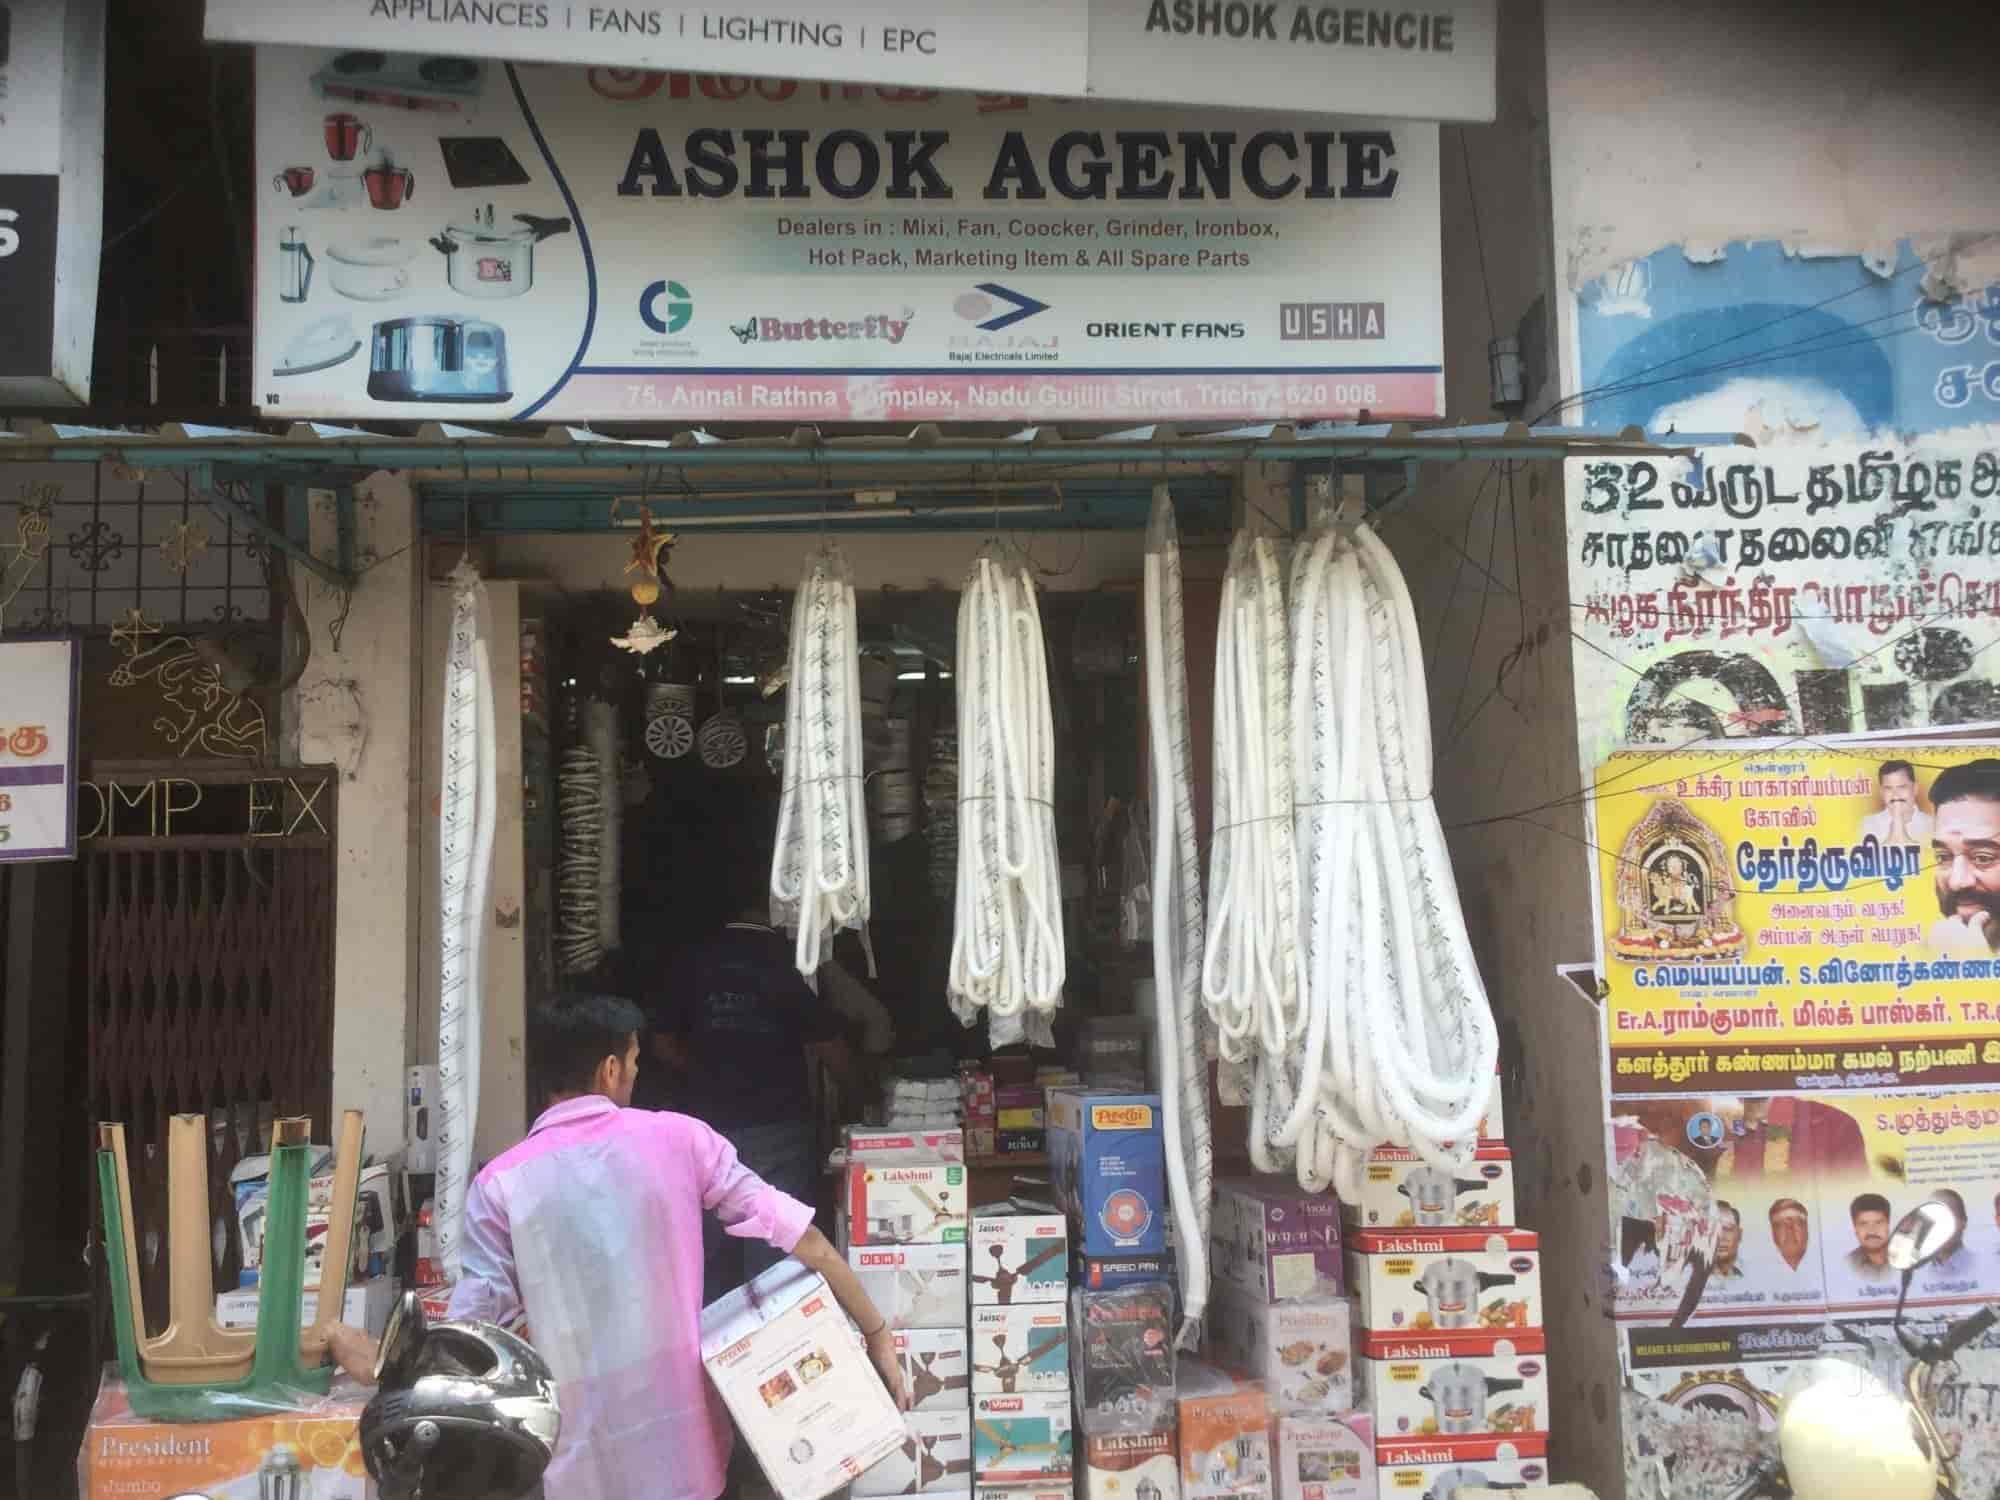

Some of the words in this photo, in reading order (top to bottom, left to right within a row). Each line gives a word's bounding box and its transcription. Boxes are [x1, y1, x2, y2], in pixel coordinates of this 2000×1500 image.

[370, 0, 548, 28] APPLIANCES
[589, 8, 662, 36] FANS
[703, 15, 843, 48] LIGHTING
[882, 27, 937, 54] EPC
[1145, 0, 1278, 41] ASHOK
[1289, 7, 1455, 52] AGENCIE
[617, 128, 953, 200] ASHOK
[982, 129, 1400, 201] AGENCIE
[777, 218, 857, 236] Dealers
[864, 218, 882, 236] in
[903, 218, 950, 238] Mixi,
[957, 218, 1002, 238] Fan,
[1008, 218, 1099, 239] Coocker,
[1106, 218, 1189, 239] Grinder,
[1195, 219, 1280, 240] Ironbox,
[809, 248, 845, 265] Hot
[852, 248, 909, 268] Pack,
[915, 248, 1018, 270] Marketing
[1024, 249, 1069, 266] Item
[1074, 249, 1091, 266] &
[1096, 249, 1124, 266] All
[1131, 249, 1190, 270] Spare
[1197, 249, 1250, 266] Parts
[1086, 322, 1176, 338] ORIENT
[1181, 322, 1245, 338] FANS
[1282, 305, 1384, 338] USHA
[671, 383, 743, 408] Annai
[751, 383, 838, 408] Rathna
[967, 383, 1032, 407] Nadu
[1737, 833, 1921, 893] தேர்திருவிழா
[1371, 1147, 1418, 1161] akshmi
[883, 1169, 933, 1182] Lakshmi
[1376, 1238, 1444, 1253] Lakshmi
[1383, 1344, 1450, 1360] Lakshmi
[101, 1435, 212, 1457] President
[1096, 1431, 1169, 1452] Lakshmi
[1386, 1447, 1454, 1465] Lakshmi
